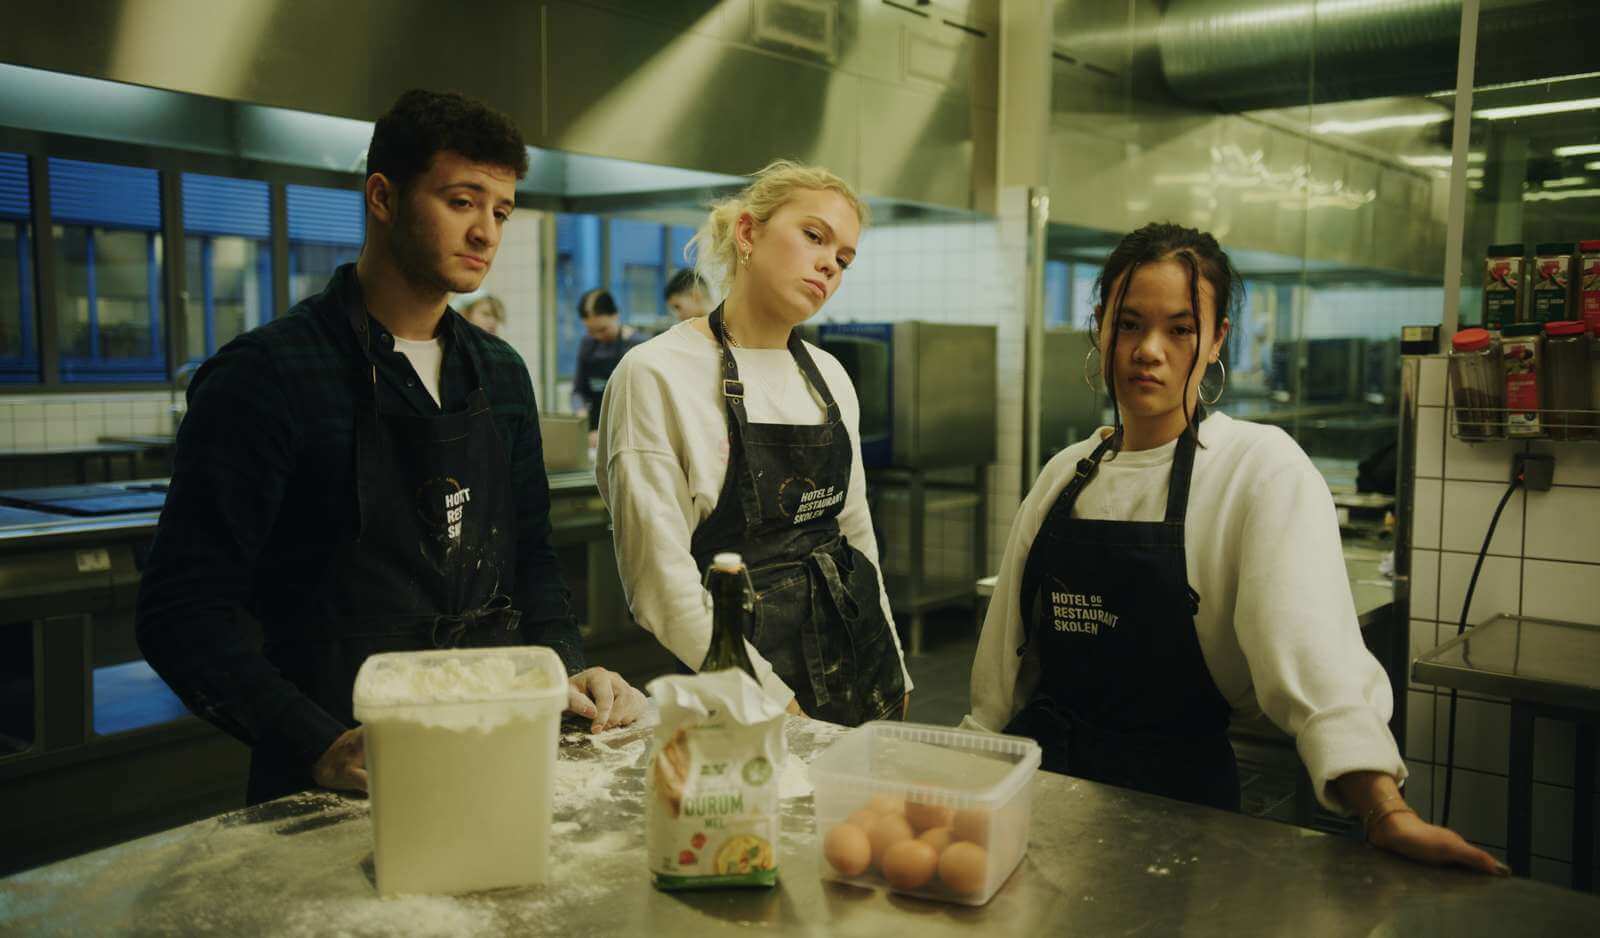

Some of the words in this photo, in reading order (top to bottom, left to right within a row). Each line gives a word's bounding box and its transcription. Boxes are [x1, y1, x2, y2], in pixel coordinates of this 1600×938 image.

[797, 491, 844, 513] RESTAURANT
[801, 488, 826, 502] HOTEL
[793, 510, 825, 525] SKOLEN
[1051, 591, 1090, 607] HOTEL
[1090, 595, 1103, 605] OG
[1053, 605, 1119, 628] RESTAURANT
[1054, 619, 1099, 636] SKOLEN
[684, 794, 744, 817] DURUM
